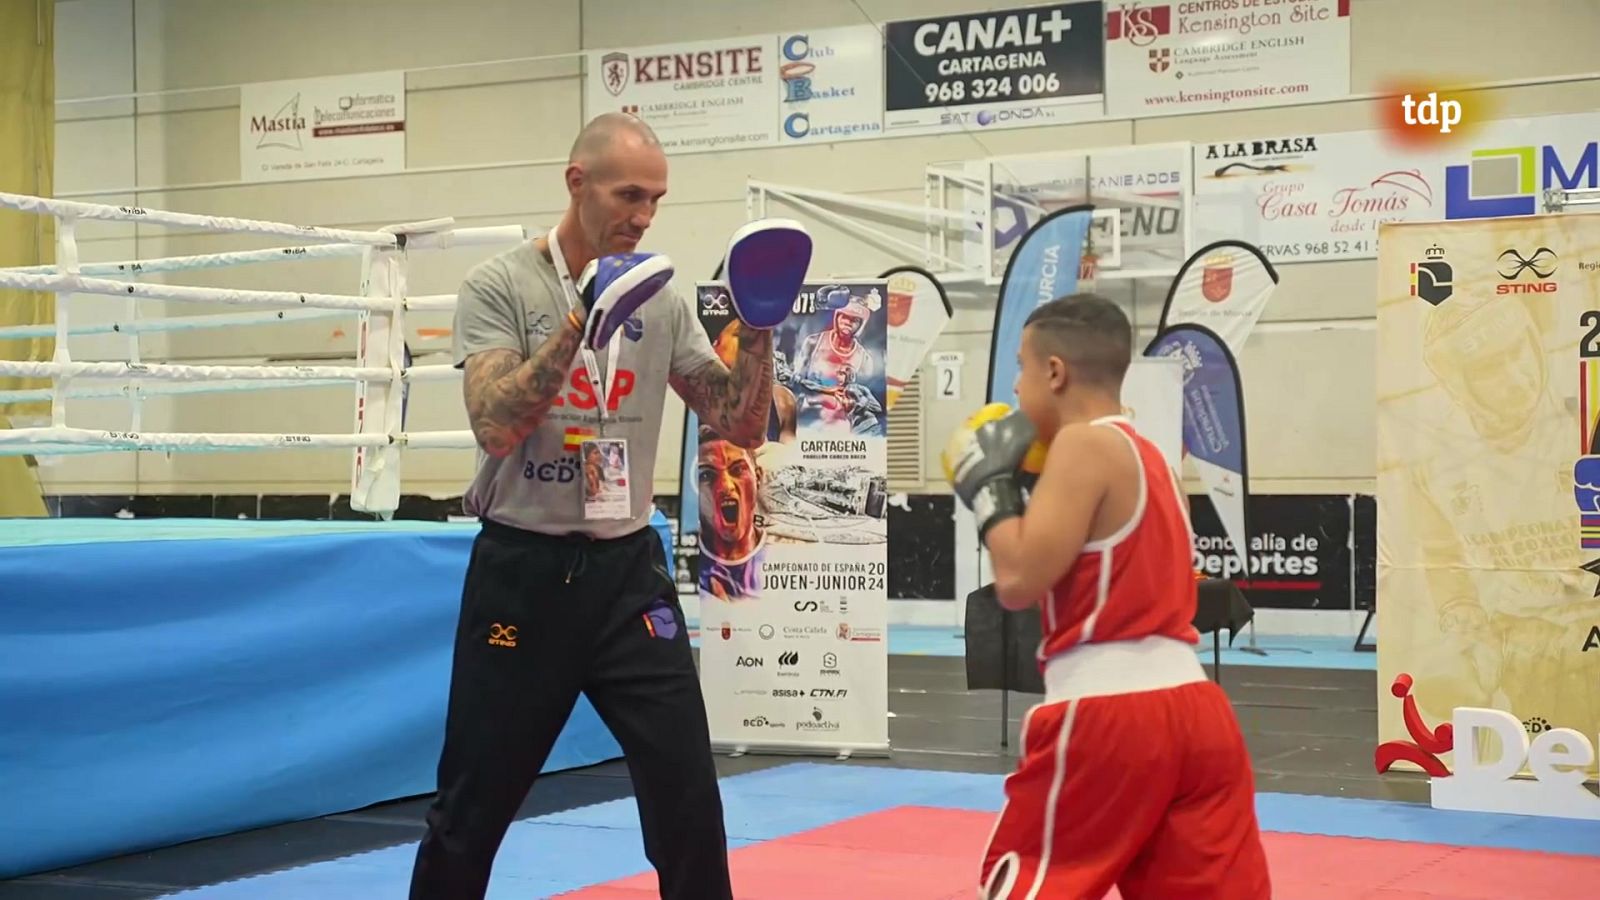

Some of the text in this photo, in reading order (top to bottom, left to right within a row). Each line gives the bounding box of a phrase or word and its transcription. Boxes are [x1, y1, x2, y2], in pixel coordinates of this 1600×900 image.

[1178, 5, 1330, 34] Kensington Site
[914, 10, 1072, 56] CANAL+
[1173, 36, 1304, 56] CAMBRIDGE ENGLISH
[634, 46, 762, 83] KENSITE
[938, 51, 1046, 76] CARTAGENA
[783, 76, 855, 103] Basket
[925, 73, 1060, 102] 968 324 006
[1144, 82, 1309, 105] www.kensingtonsite.com
[251, 114, 306, 133] Mastia
[784, 112, 880, 138] Cartagena
[1206, 145, 1220, 159] A
[1223, 142, 1250, 158] LA
[1252, 137, 1318, 156] BRASA
[1263, 181, 1304, 196] Grupo
[1256, 187, 1408, 221] Casa Tomás
[1305, 242, 1329, 255] 968
[1334, 241, 1349, 253] 52
[1354, 240, 1368, 252] 41
[1496, 282, 1558, 295] STING
[943, 368, 954, 395] 2
[801, 440, 867, 453] CARTAGENA
[1291, 532, 1318, 551] de
[762, 561, 866, 573] CAMPEONATO DE ESPAÑA
[868, 562, 885, 575] 20
[763, 574, 866, 590] JOVEN-JUNIOR
[868, 577, 884, 590] 24
[736, 656, 763, 667] AON
[772, 689, 798, 697] asisa
[1452, 706, 1595, 784] De
